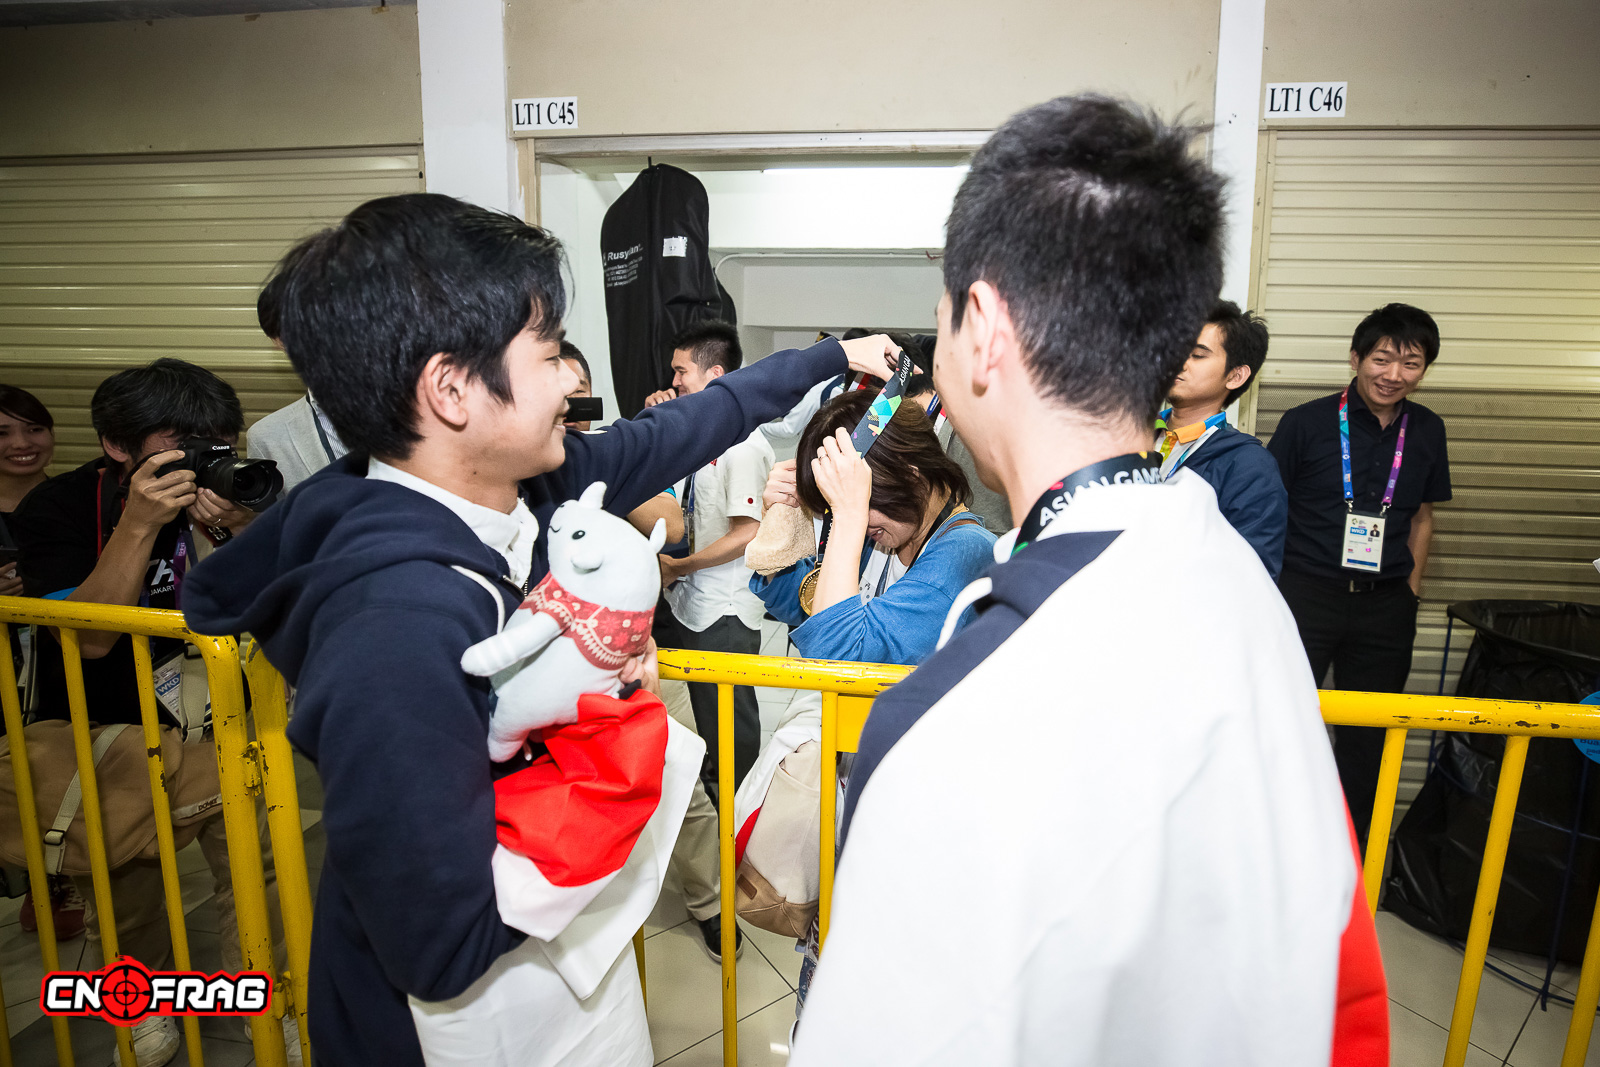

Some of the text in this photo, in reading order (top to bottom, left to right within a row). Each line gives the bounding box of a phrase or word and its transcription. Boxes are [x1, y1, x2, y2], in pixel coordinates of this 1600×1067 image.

[1269, 86, 1344, 112] LT1 C46
[515, 102, 575, 125] LT1 C45
[158, 677, 180, 693] WKD
